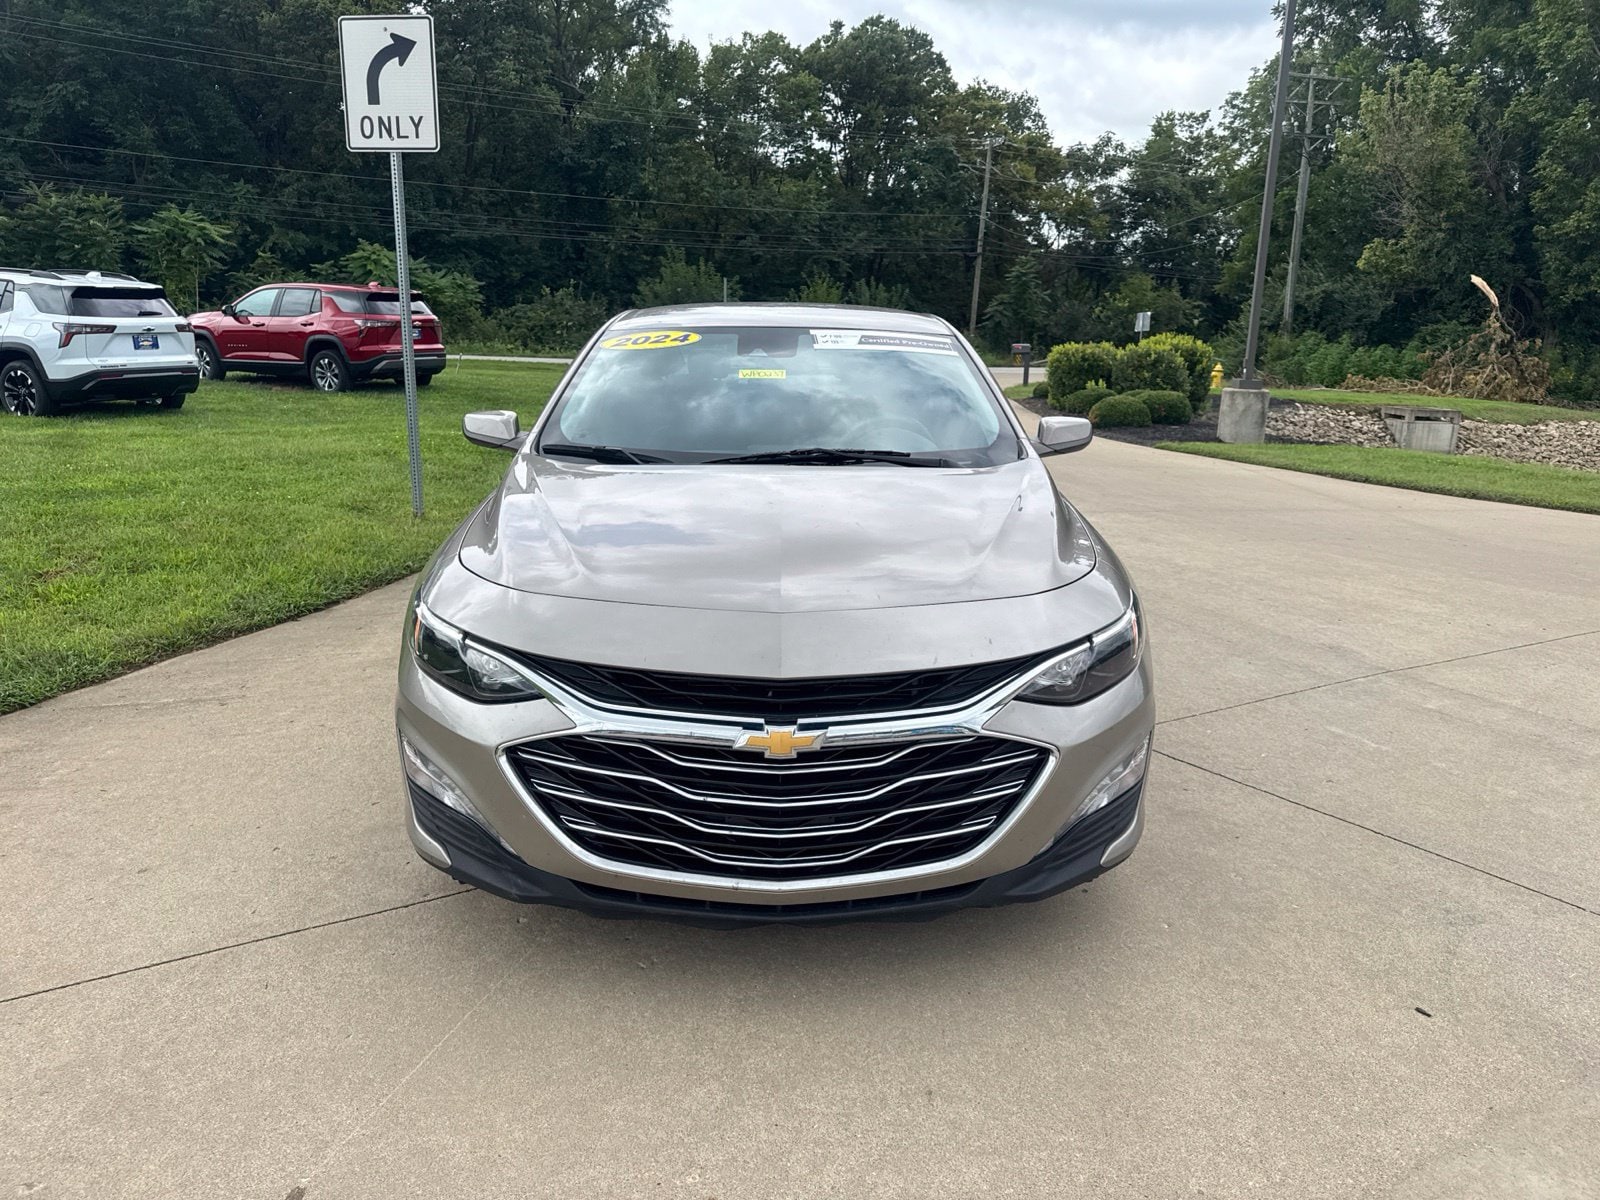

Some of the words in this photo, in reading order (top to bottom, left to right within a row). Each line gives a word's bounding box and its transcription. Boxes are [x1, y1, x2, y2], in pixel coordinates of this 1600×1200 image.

[360, 115, 424, 139] ONLY
[610, 333, 692, 347] 2024
[861, 337, 900, 345] Certified
[901, 339, 949, 349] Pre-Owned
